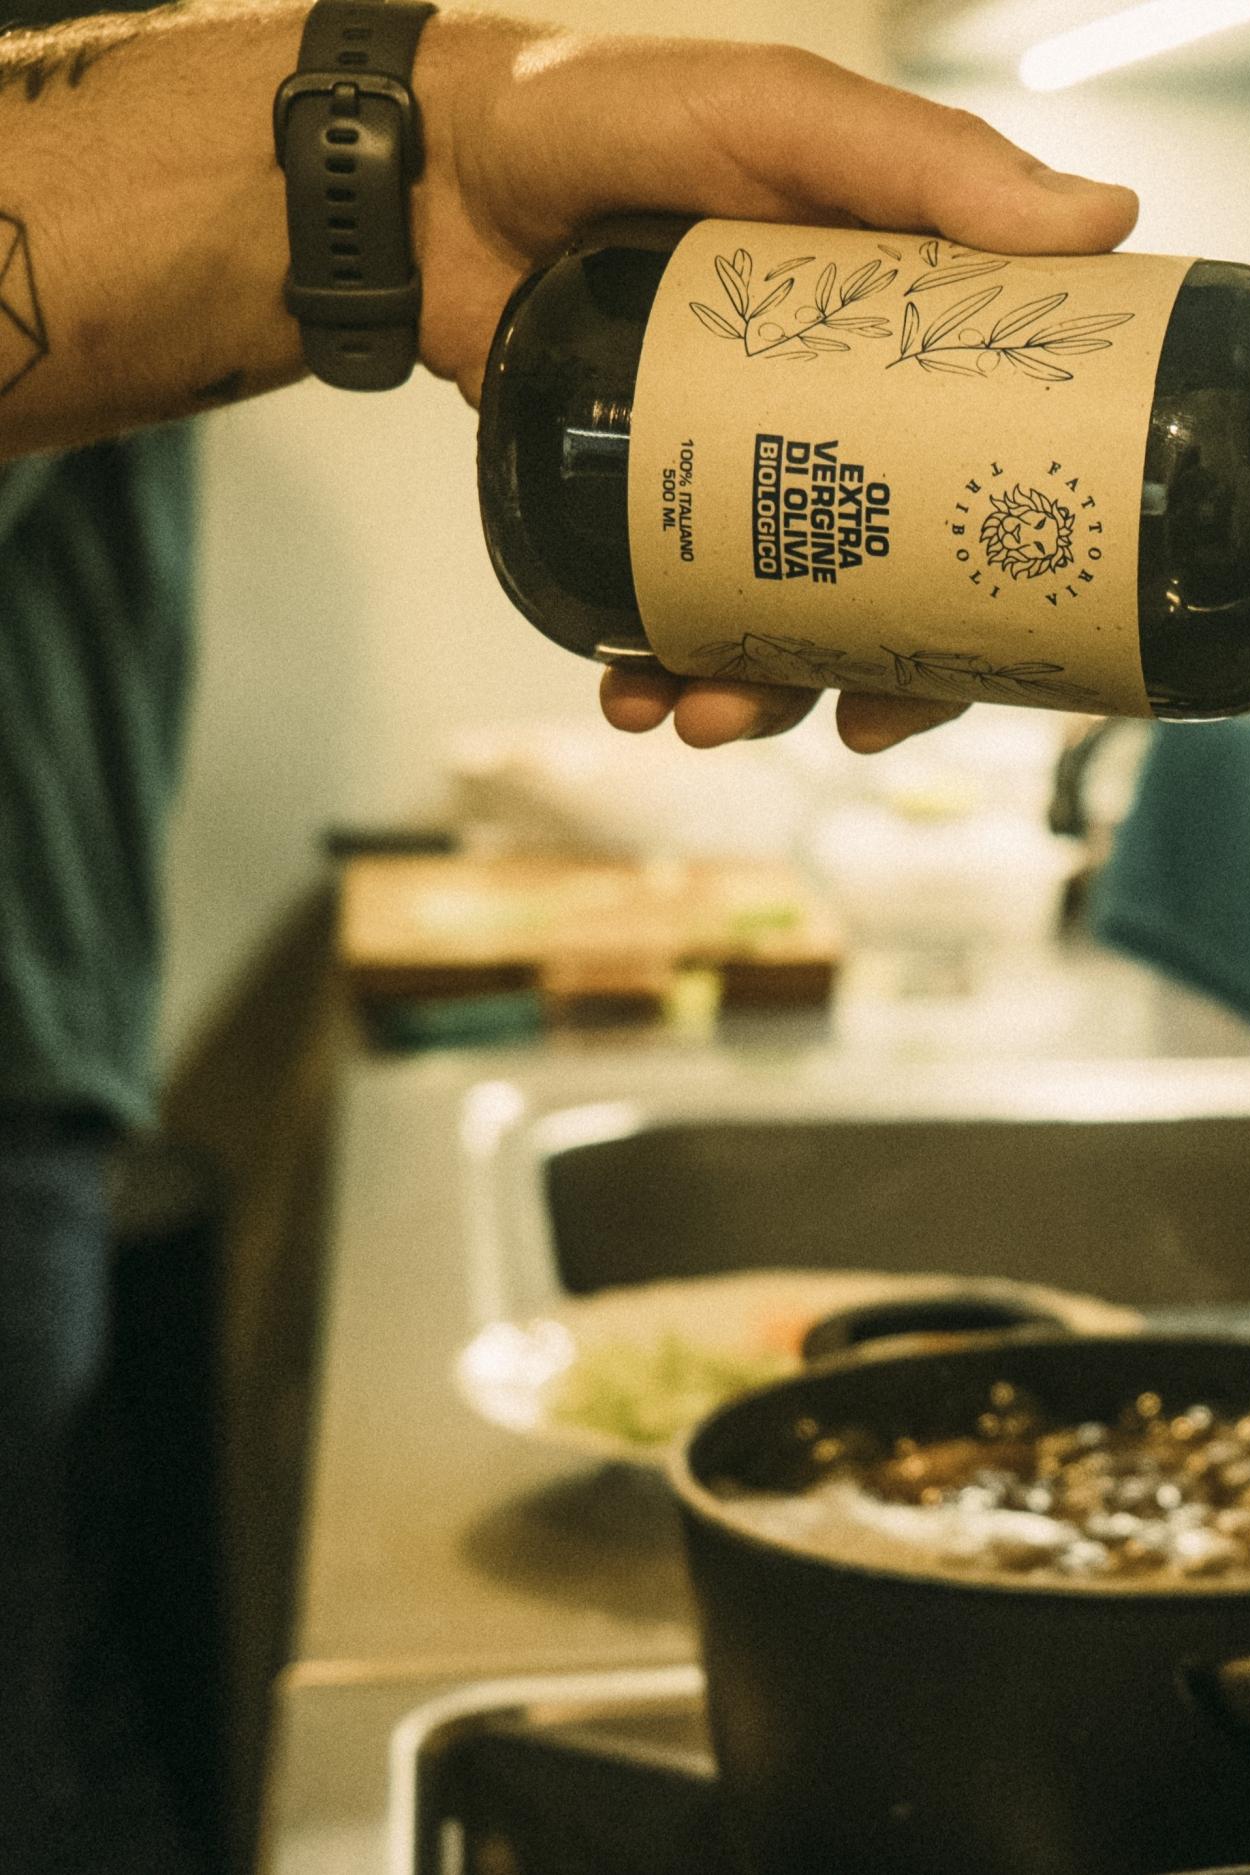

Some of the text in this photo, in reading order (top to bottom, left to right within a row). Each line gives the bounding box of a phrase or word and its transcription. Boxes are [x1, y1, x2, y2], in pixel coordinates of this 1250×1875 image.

[662, 468, 676, 532] 500 ML
[679, 439, 694, 563] 100% ITALIANO
[756, 441, 779, 574] BIOLOGICO
[783, 441, 811, 579] DI OLIVA
[810, 440, 839, 585] VERGINE
[838, 463, 864, 570] EXTRA
[864, 482, 890, 558] OLIO
[952, 462, 1003, 599] TRIBOLI
[1045, 461, 1103, 606] FATTORIA
